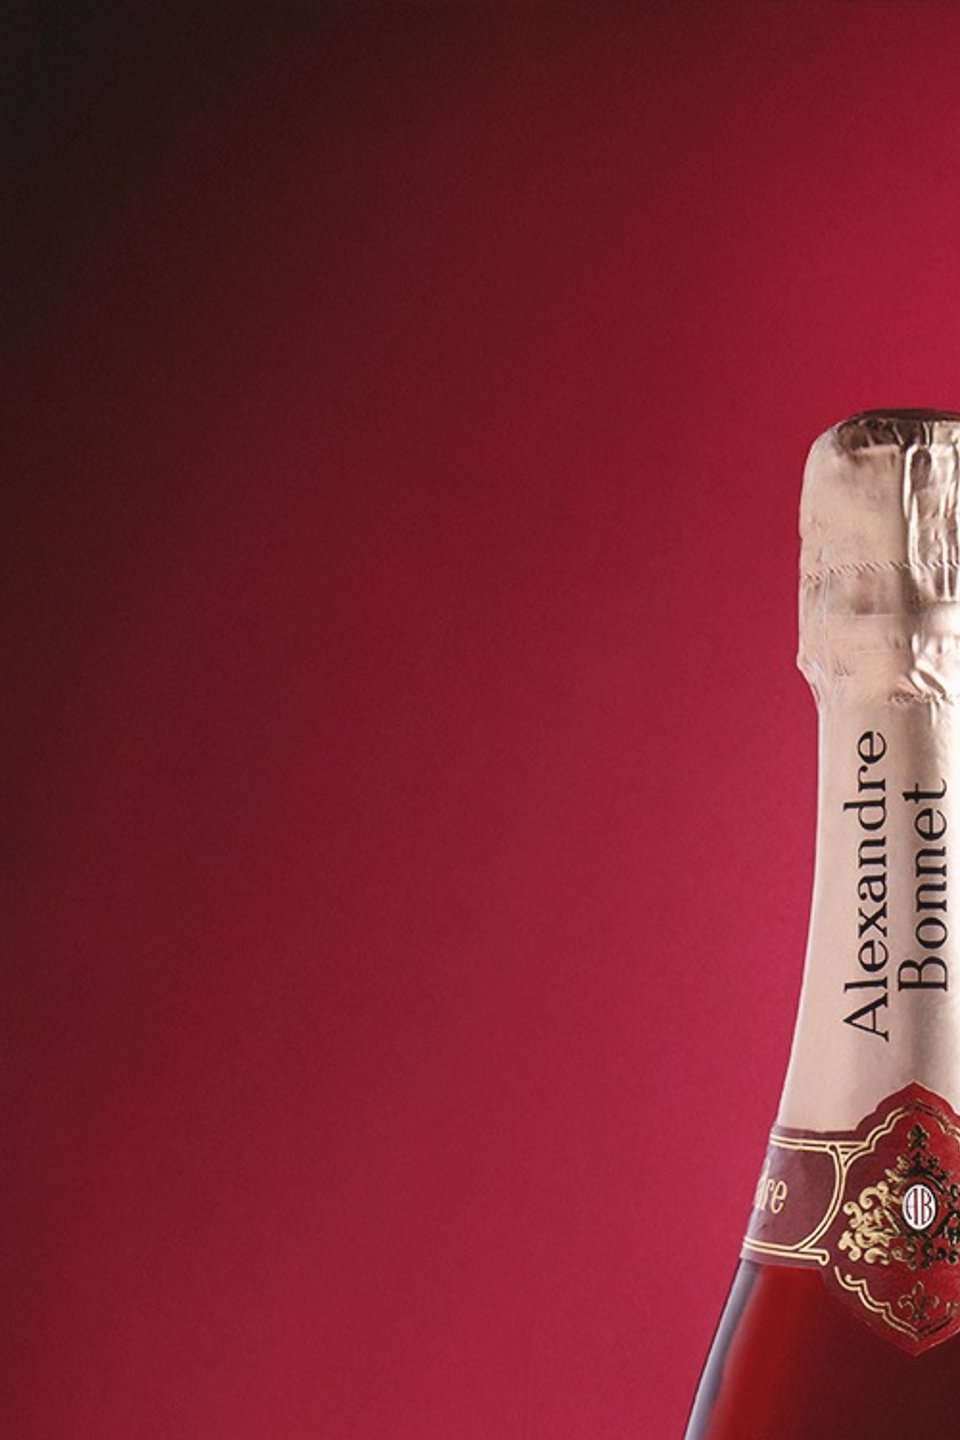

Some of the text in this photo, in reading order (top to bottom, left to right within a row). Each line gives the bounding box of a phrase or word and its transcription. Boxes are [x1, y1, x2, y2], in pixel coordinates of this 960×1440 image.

[843, 730, 889, 1041] Alexandre
[898, 779, 948, 992] Bonnet
[905, 1187, 936, 1228] AB
